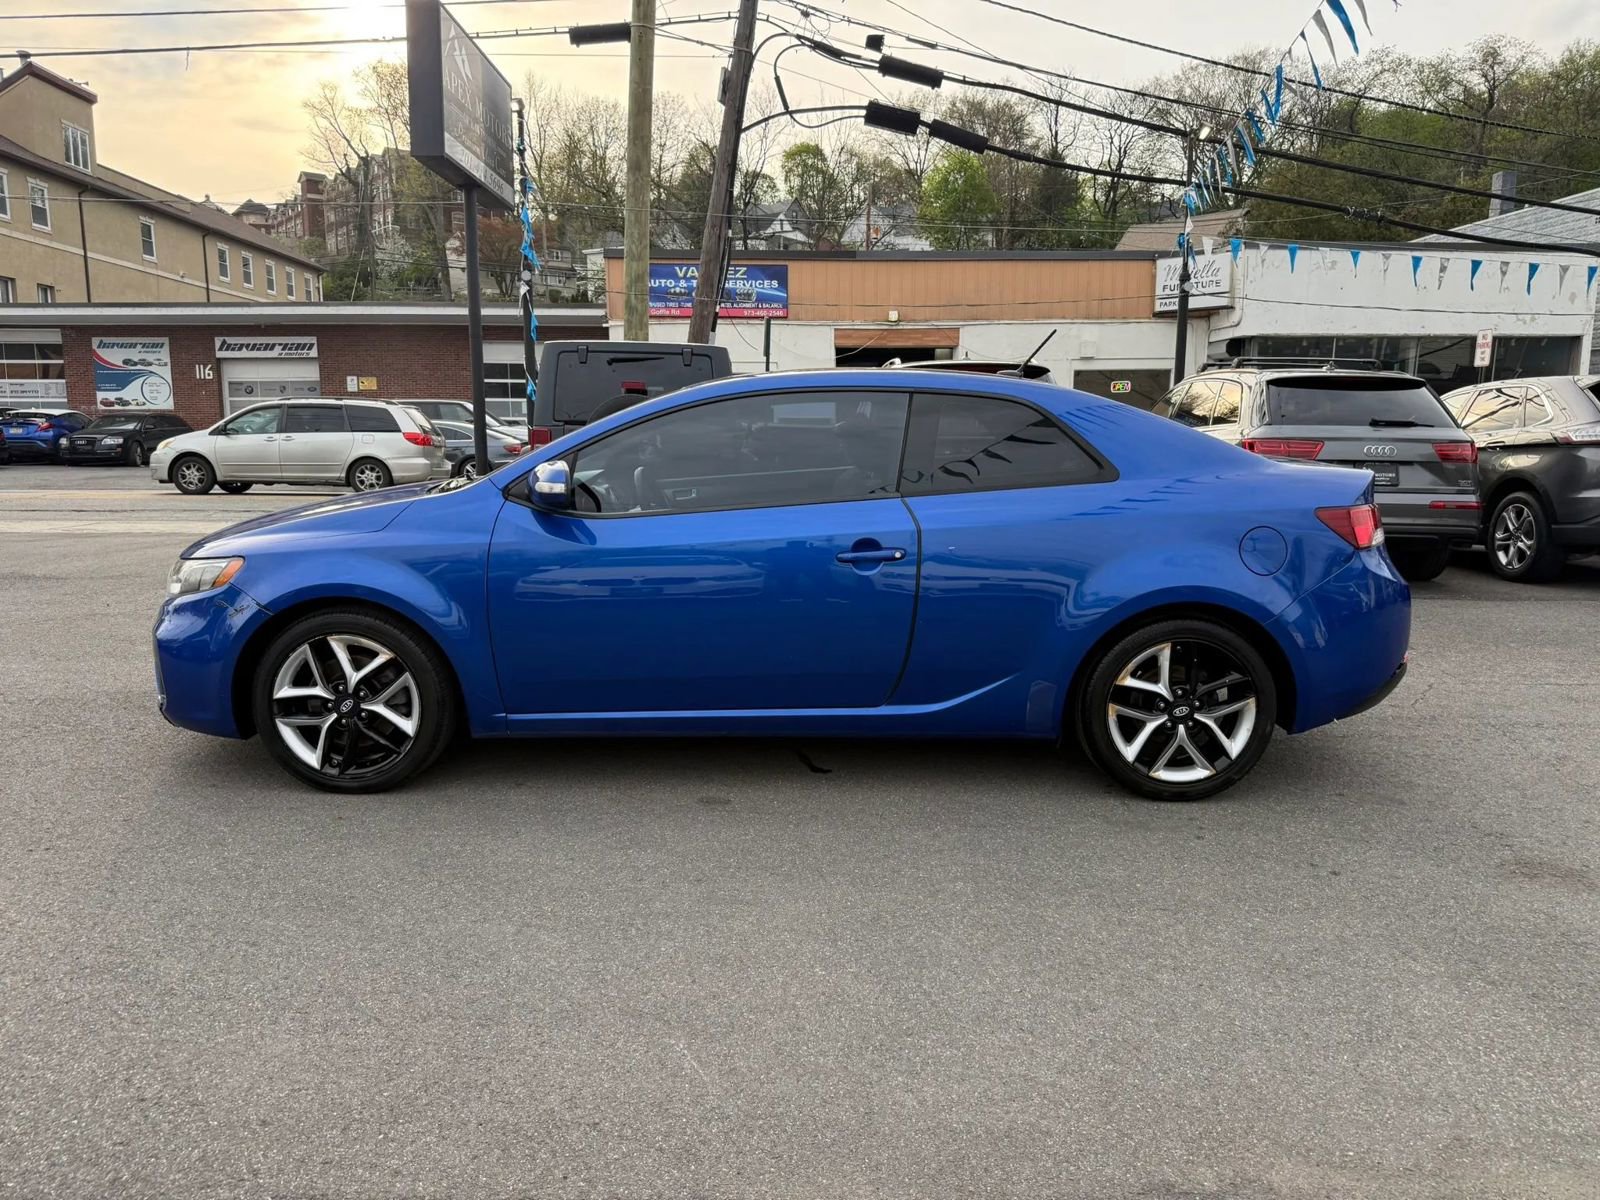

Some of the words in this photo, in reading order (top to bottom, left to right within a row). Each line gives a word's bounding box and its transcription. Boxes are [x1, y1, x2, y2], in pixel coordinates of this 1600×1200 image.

[443, 67, 472, 111] APEX
[475, 96, 512, 150] MOTORS
[1162, 280, 1221, 292] FUTURE
[97, 339, 165, 349] bavarian
[217, 338, 315, 352] bavarian
[195, 364, 213, 379] 116
